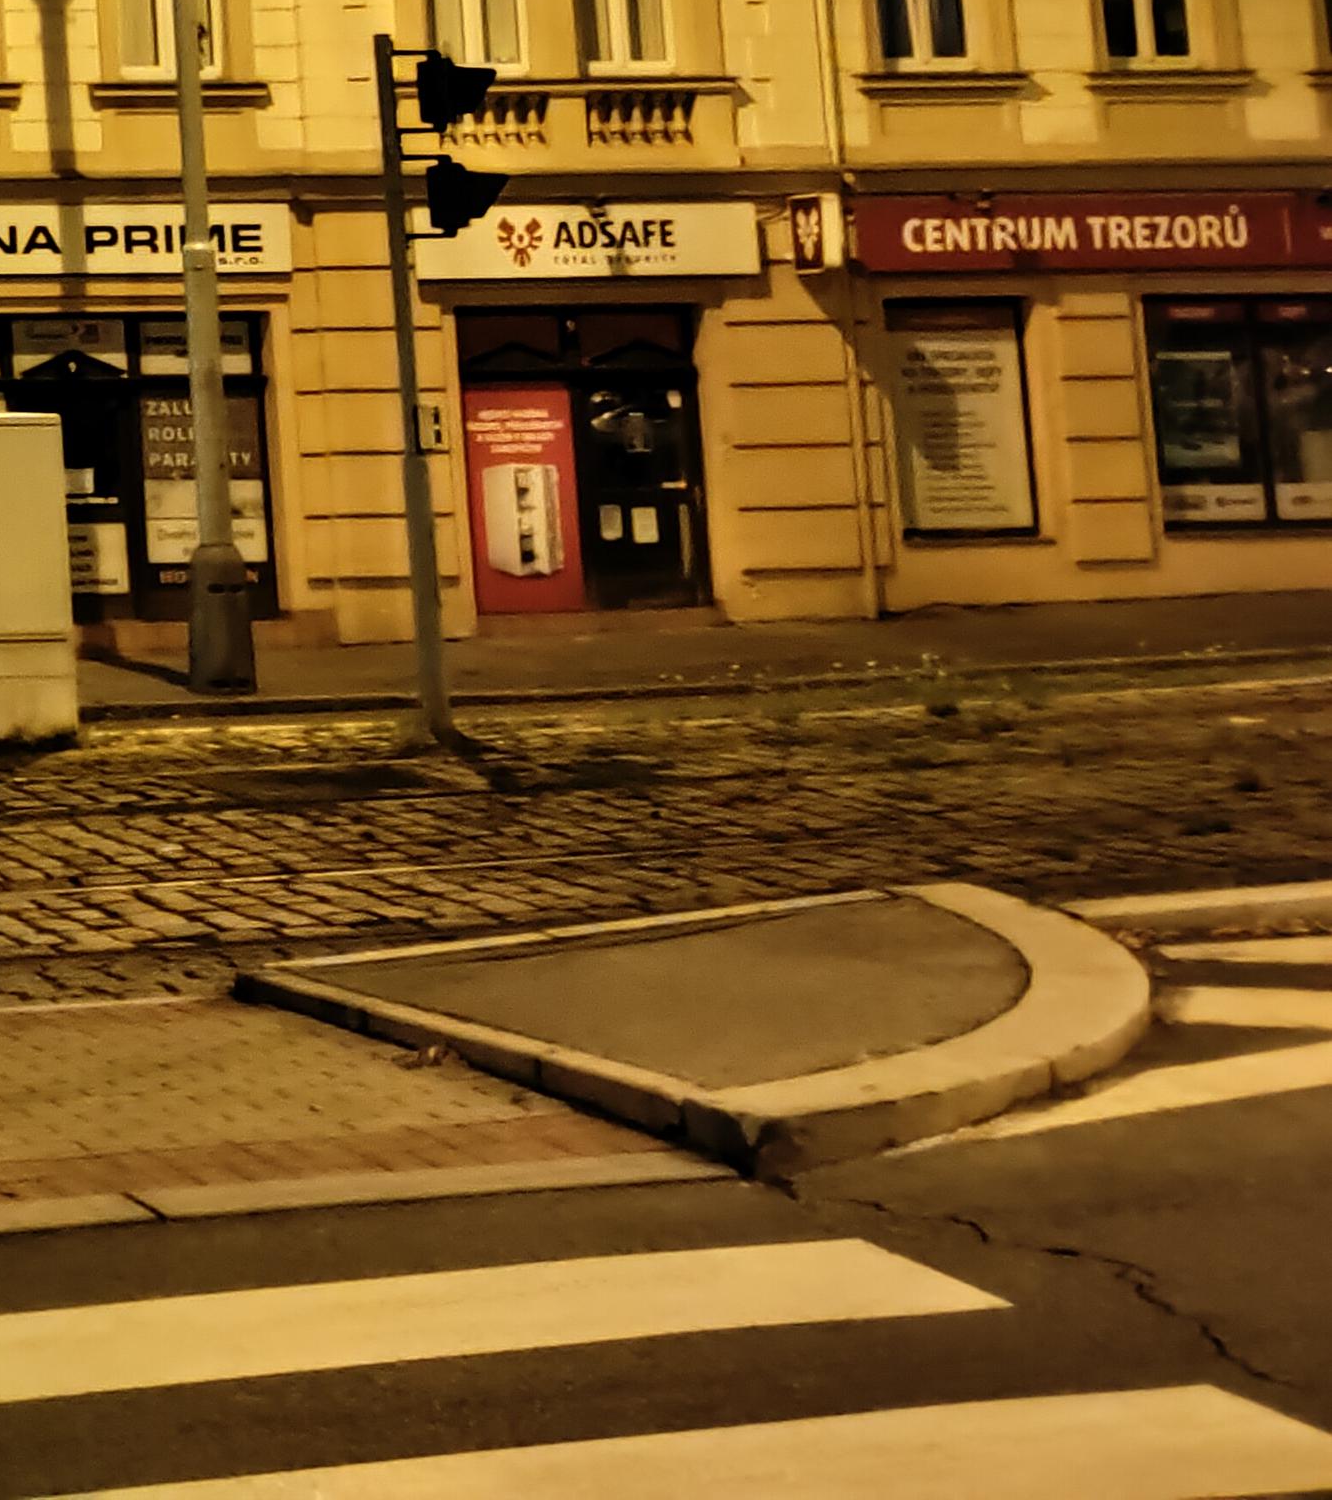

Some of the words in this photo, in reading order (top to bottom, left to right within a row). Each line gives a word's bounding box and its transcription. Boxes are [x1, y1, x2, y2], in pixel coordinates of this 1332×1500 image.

[553, 219, 677, 249] ADSAFE
[902, 217, 1078, 252] CENTRUM
[1086, 204, 1249, 250] TREZORŮ
[147, 452, 251, 468] PARTY
